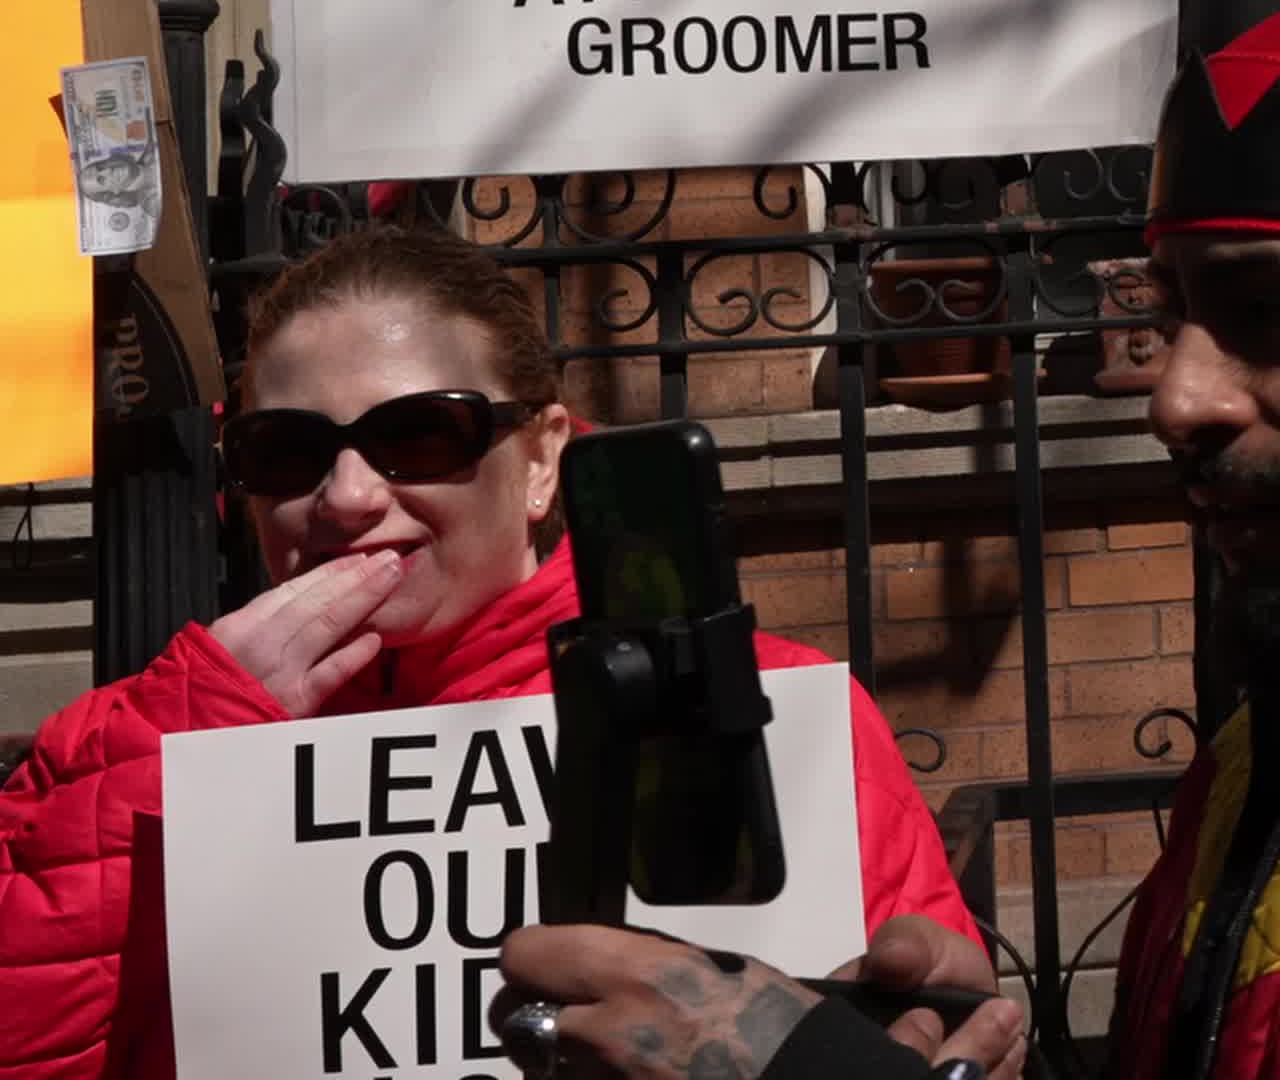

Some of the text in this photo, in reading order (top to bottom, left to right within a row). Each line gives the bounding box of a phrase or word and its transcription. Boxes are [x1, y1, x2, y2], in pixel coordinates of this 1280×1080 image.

[567, 12, 931, 76] GROOMER
[363, 841, 550, 951] OU
[320, 956, 512, 1074] KID
